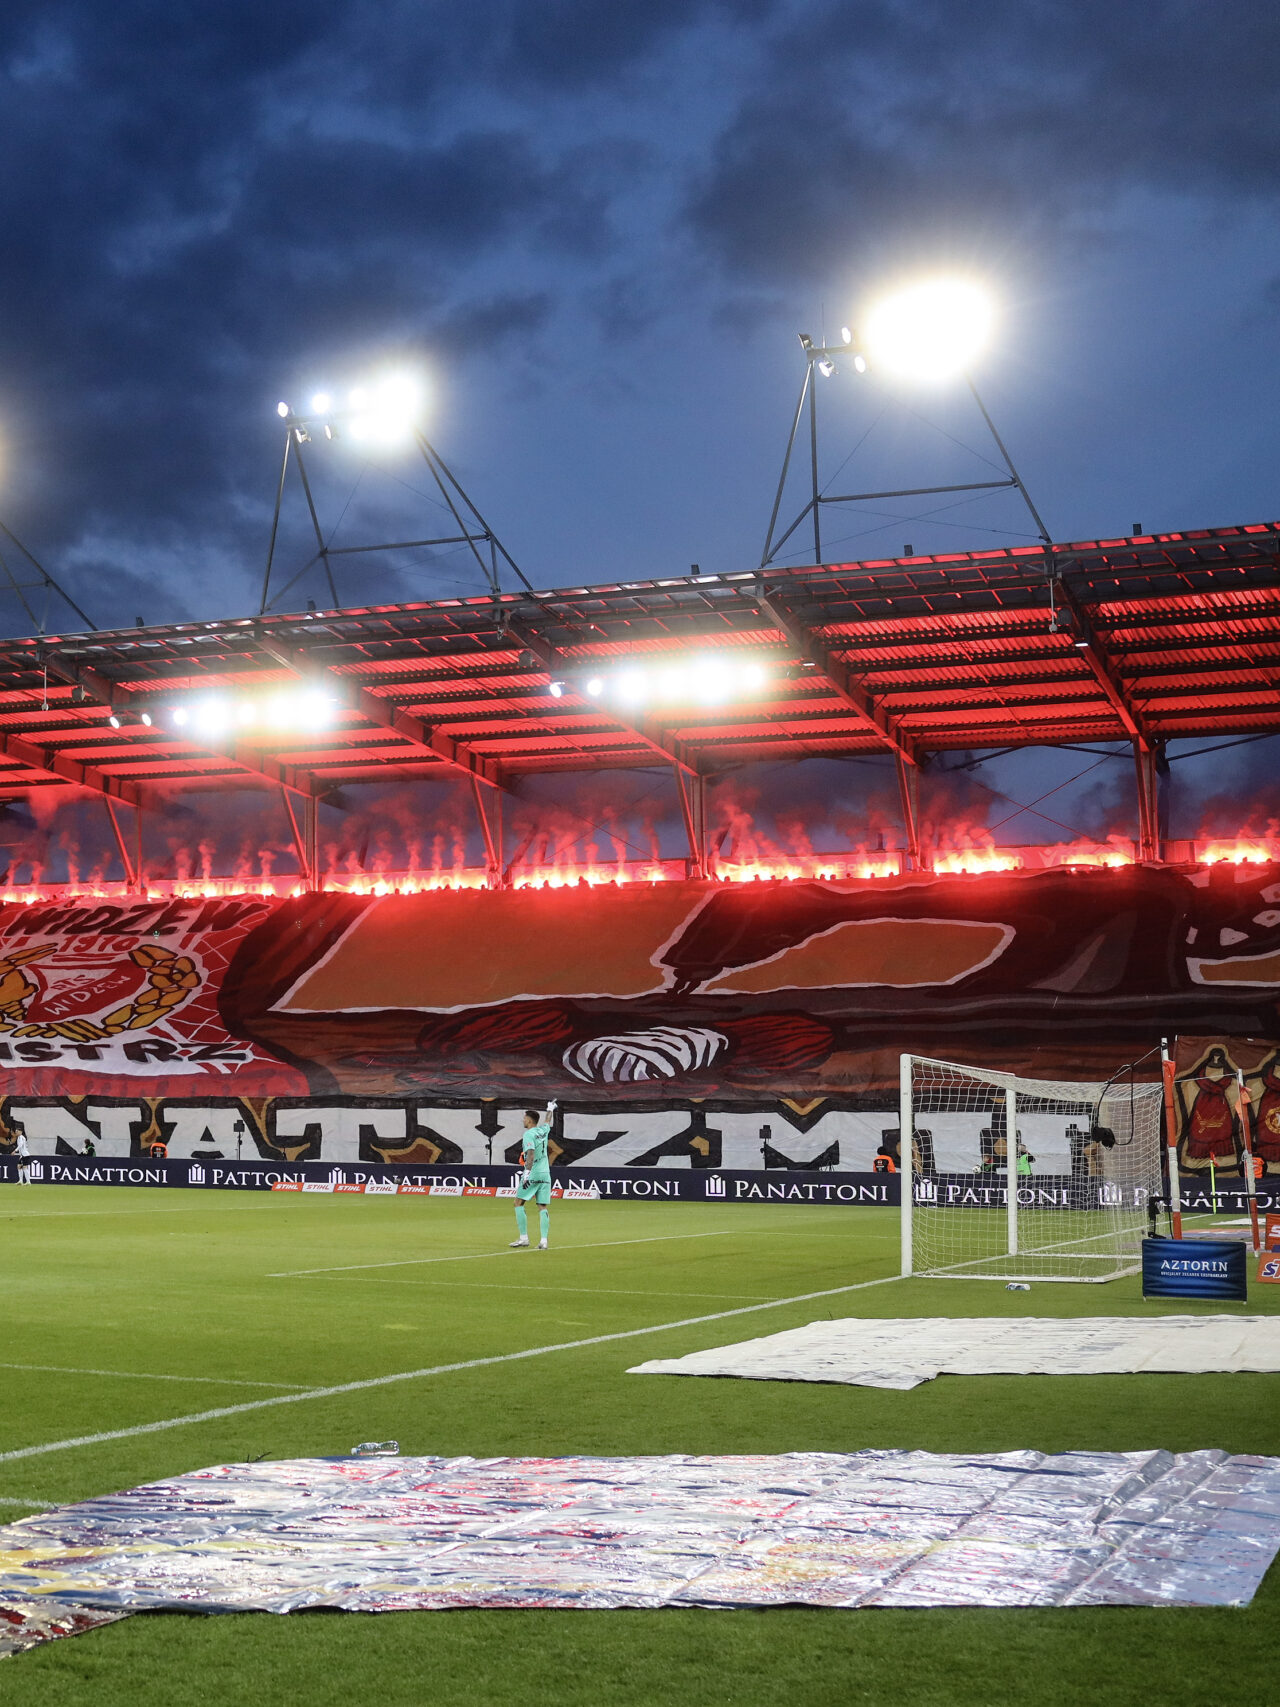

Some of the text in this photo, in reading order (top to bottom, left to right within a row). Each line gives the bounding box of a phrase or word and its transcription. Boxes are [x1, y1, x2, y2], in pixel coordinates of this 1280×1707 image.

[4, 902, 270, 936] WIDZEW
[50, 1164, 168, 1183] PANATTONI
[213, 1170, 307, 1187] PATTONI
[353, 1172, 487, 1187] PANATTONI
[552, 1178, 680, 1196] ANATTONI
[735, 1179, 888, 1201] PANATTONI
[947, 1184, 1071, 1205] PATTONI
[1133, 1186, 1280, 1210] PNATTO
[1160, 1259, 1228, 1272] AZTORIN
